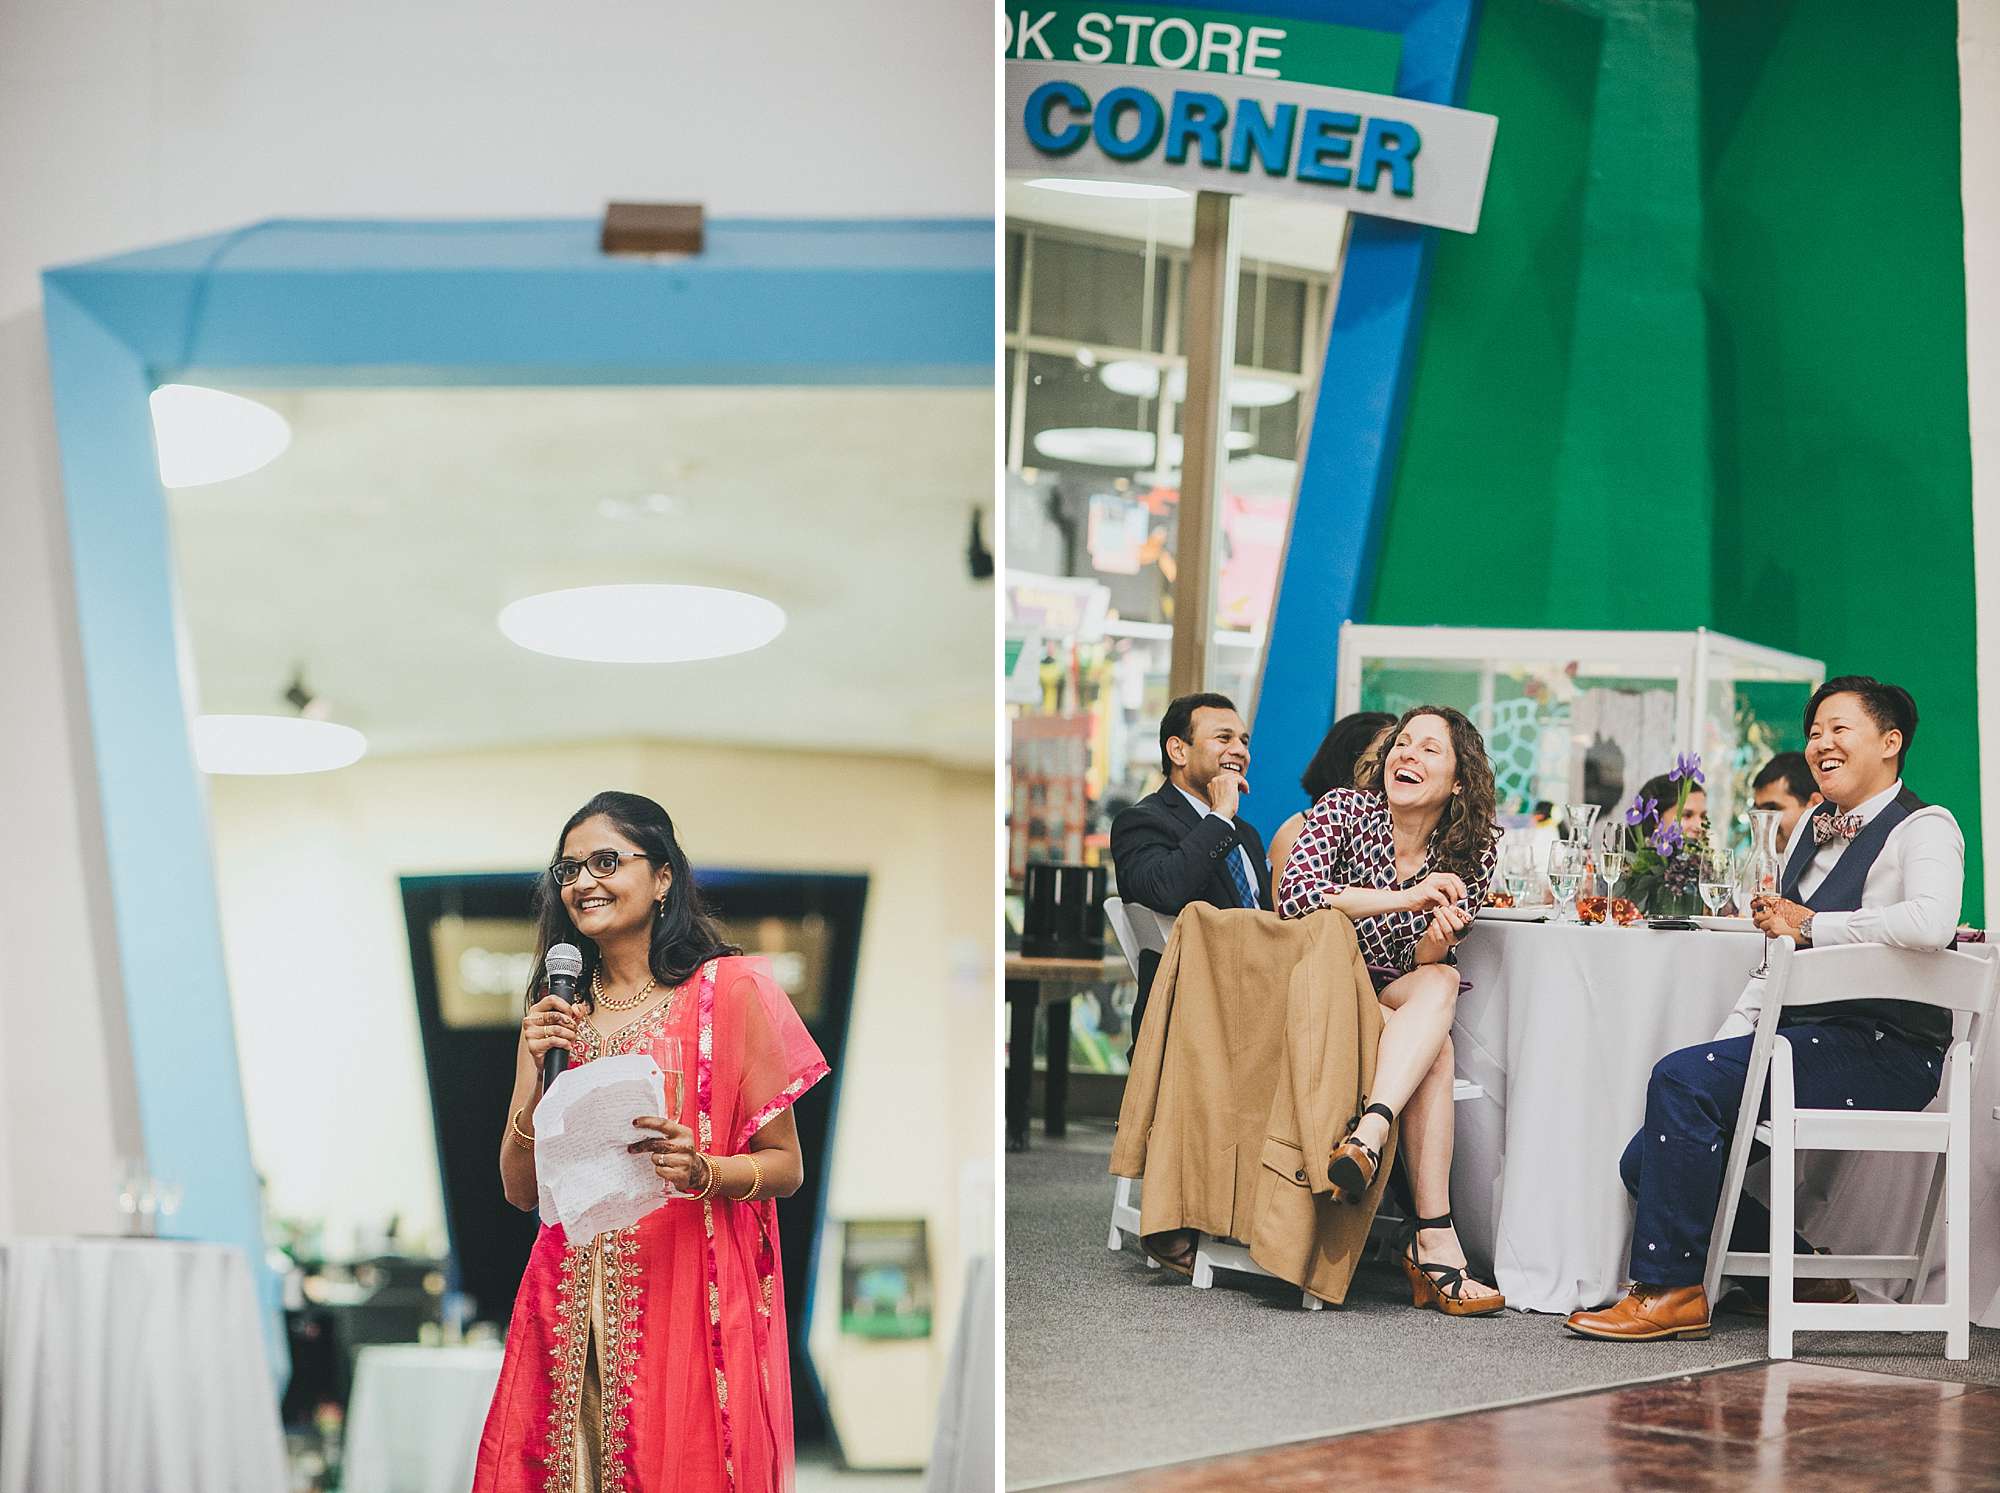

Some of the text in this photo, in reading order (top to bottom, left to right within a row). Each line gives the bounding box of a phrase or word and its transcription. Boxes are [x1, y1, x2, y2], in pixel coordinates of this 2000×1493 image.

[1005, 11, 1287, 79] K STORE
[1024, 80, 1421, 198] CORNER
